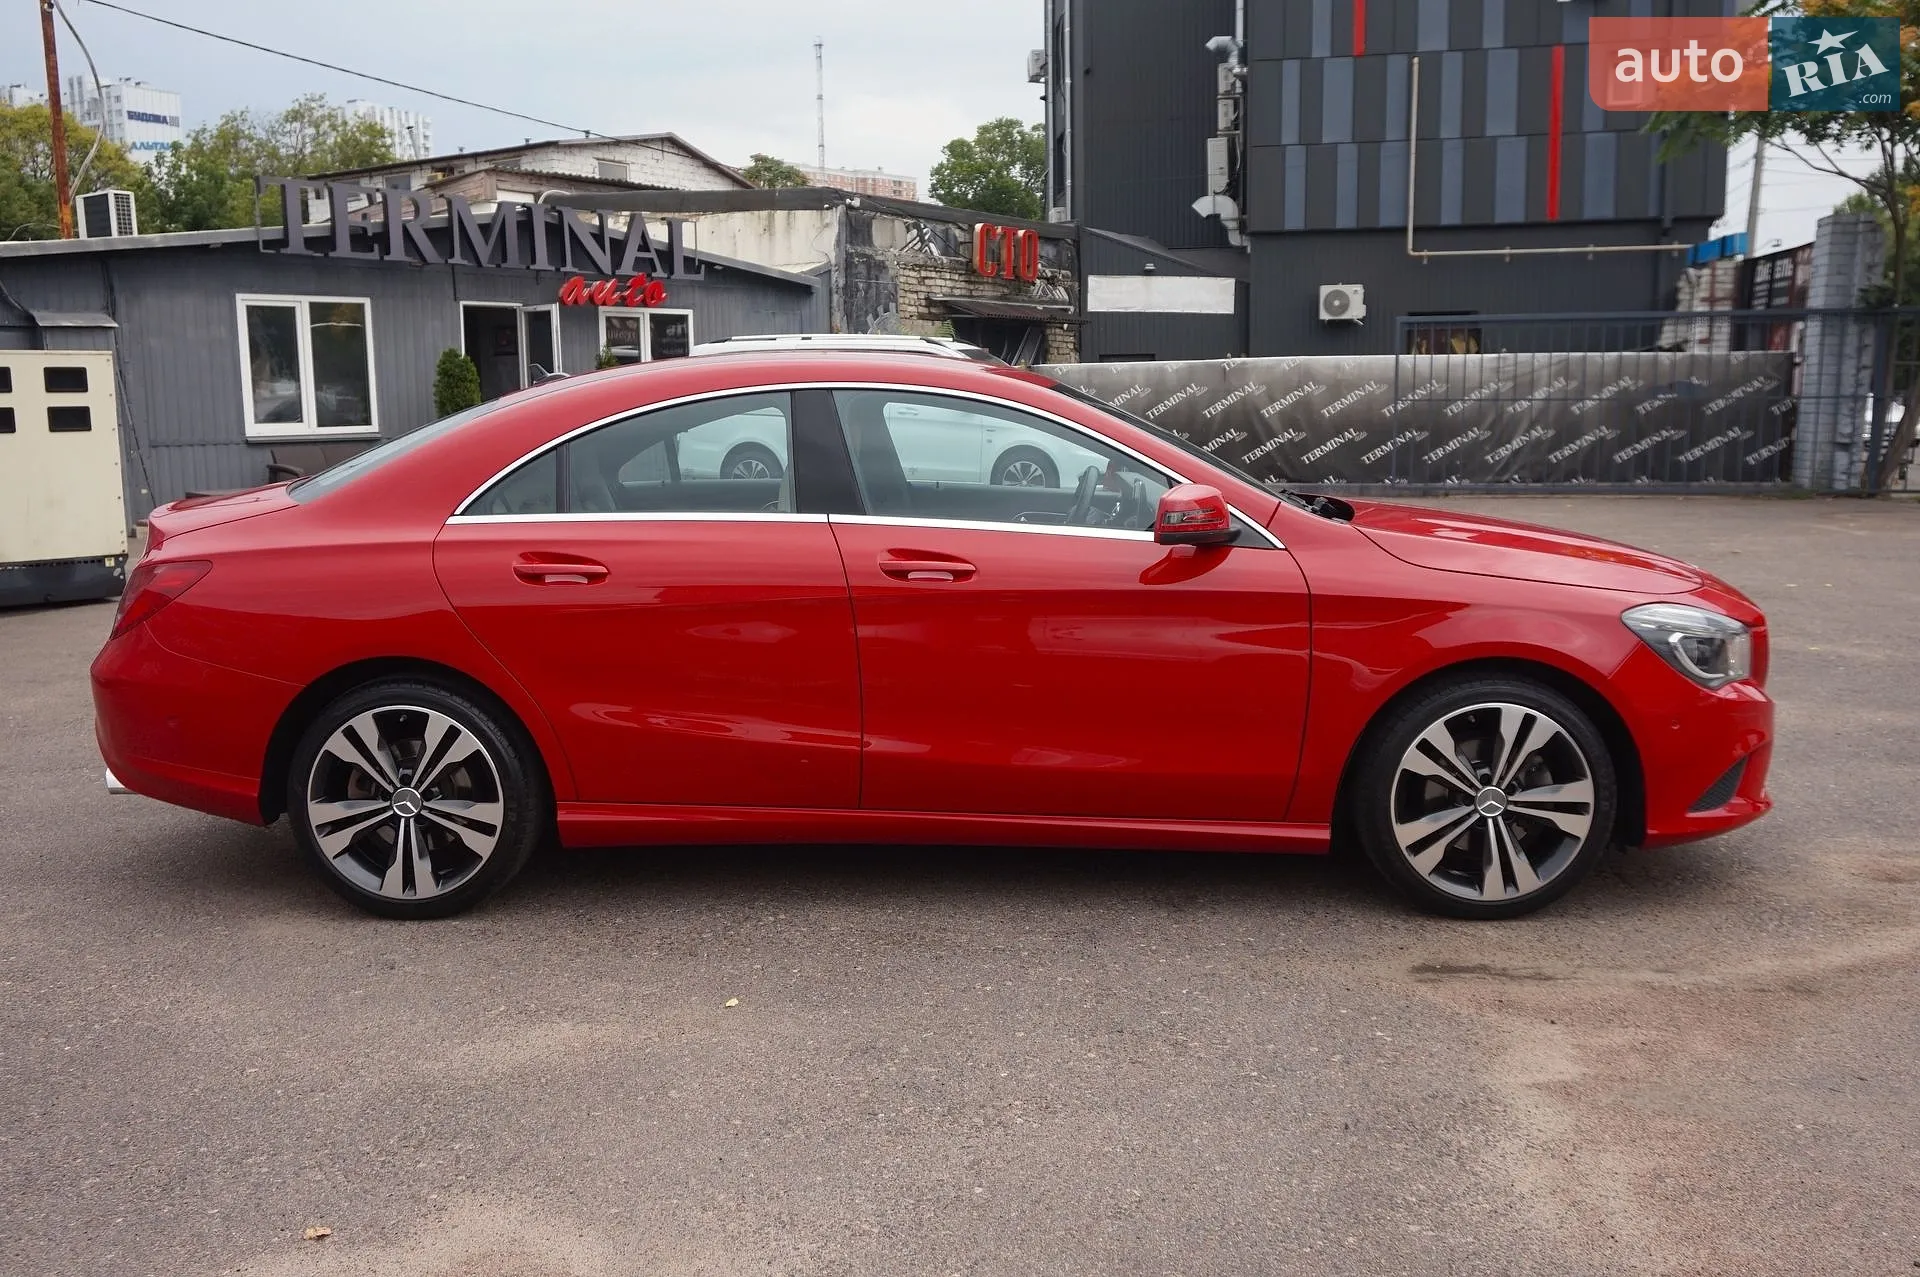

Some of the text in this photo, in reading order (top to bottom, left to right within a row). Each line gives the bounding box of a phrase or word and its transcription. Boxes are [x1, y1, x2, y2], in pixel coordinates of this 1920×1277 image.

[255, 175, 705, 281] TERMINAL
[974, 223, 1039, 282] СТО
[557, 272, 668, 308] auto
[1145, 383, 1200, 420] TERMINAL
[1202, 381, 1258, 419] TERMINAL
[1260, 381, 1319, 419] TERMINAL
[1320, 380, 1380, 418] TERMINAL
[1241, 428, 1299, 465] TERMINAL
[1300, 428, 1359, 465] TERMINAL
[1360, 428, 1421, 465] TERMNAL
[1422, 426, 1481, 464] TERMINAL
